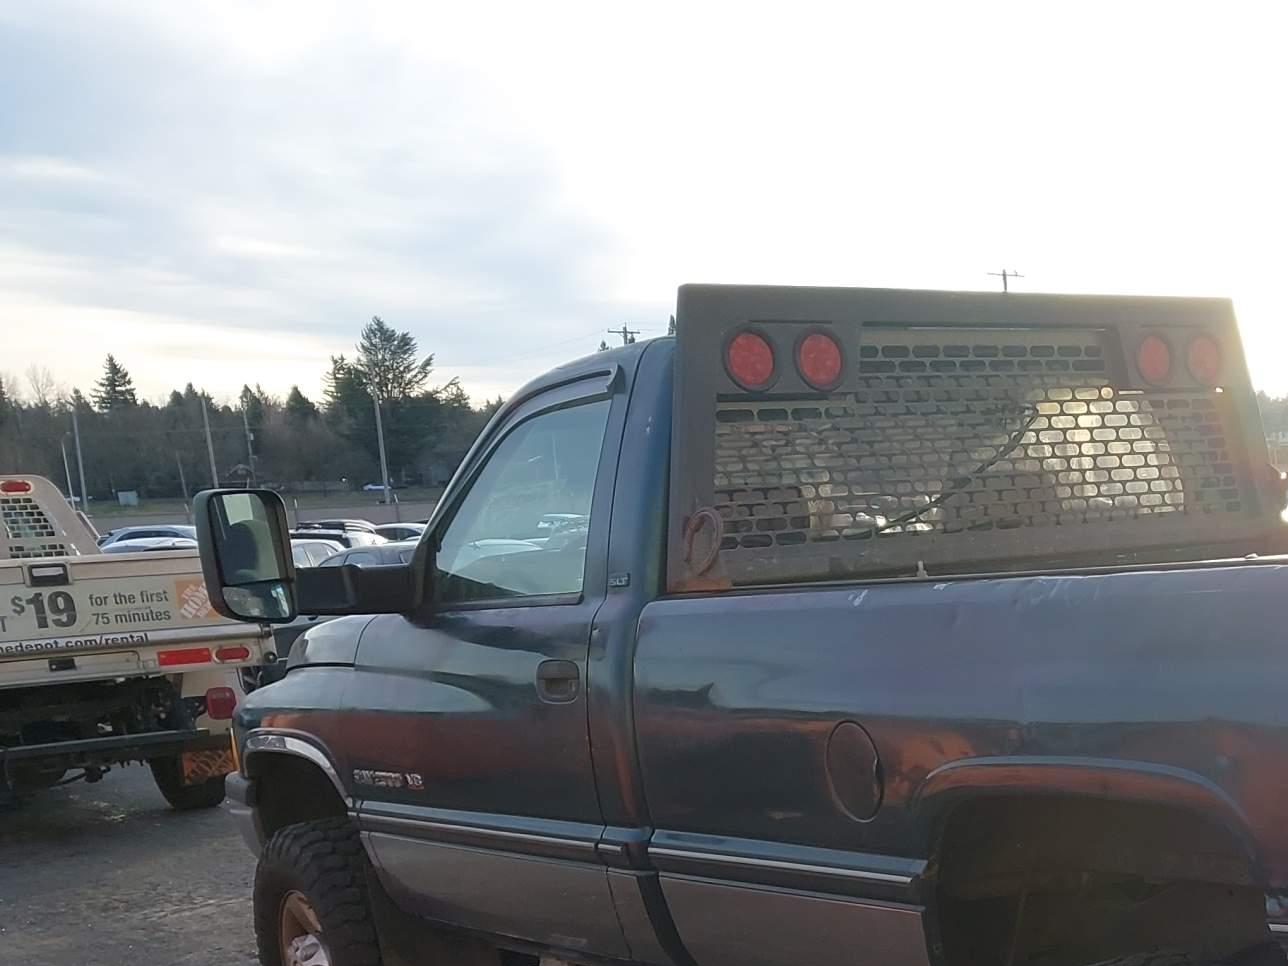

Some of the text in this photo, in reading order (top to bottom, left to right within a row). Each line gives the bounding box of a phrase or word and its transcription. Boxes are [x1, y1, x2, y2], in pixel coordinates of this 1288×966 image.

[88, 590, 168, 608] for the first
[12, 590, 77, 629] $19
[92, 608, 171, 626] 75 minutes
